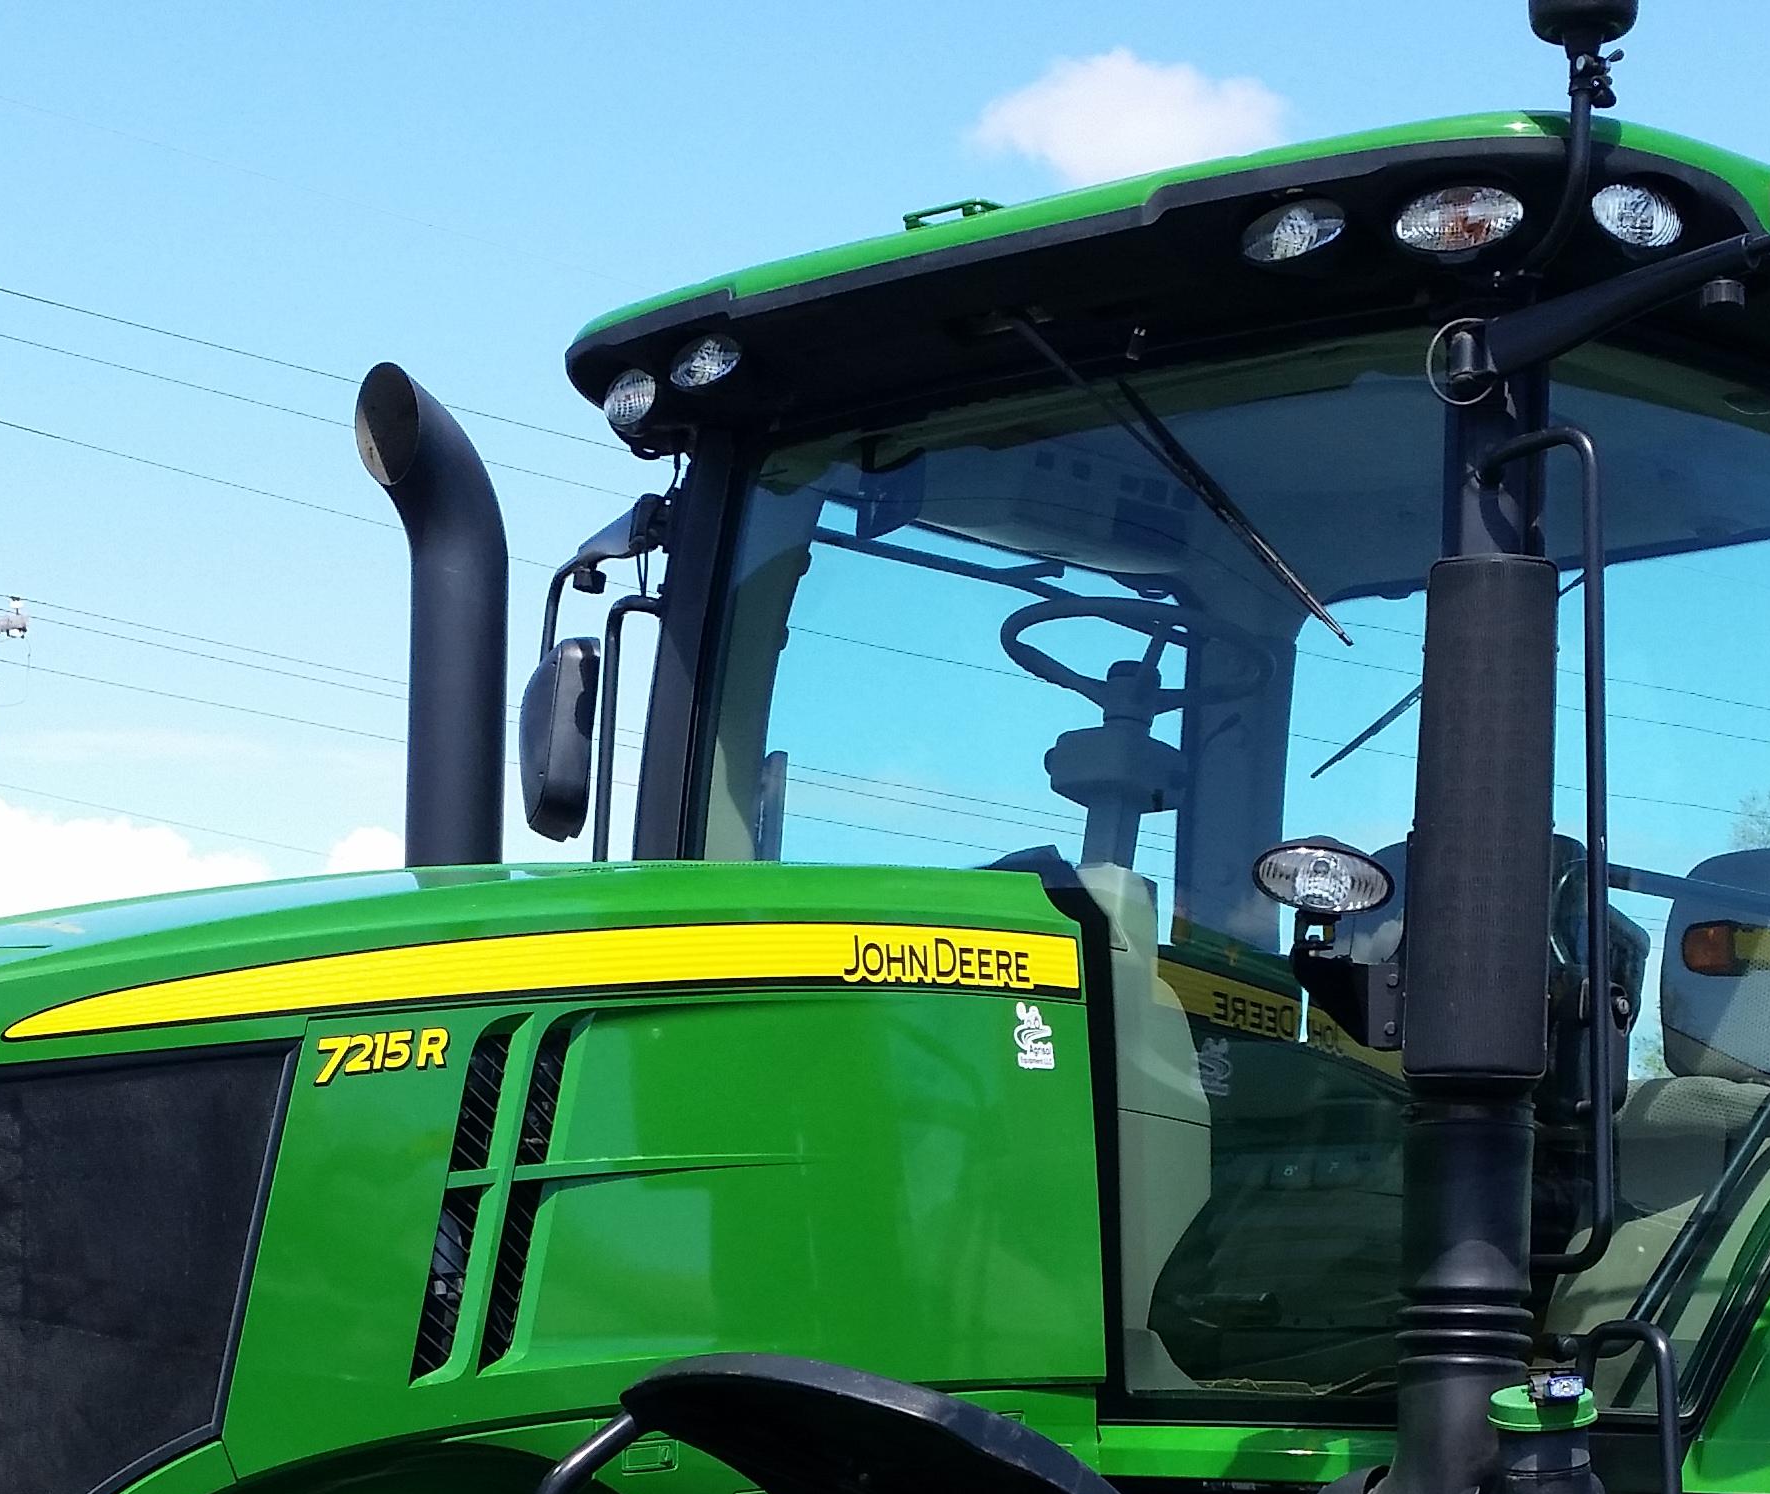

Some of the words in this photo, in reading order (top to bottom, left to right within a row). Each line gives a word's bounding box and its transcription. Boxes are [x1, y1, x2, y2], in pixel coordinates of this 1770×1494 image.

[843, 934, 928, 977] JOHN
[934, 937, 1031, 983] DEERE
[313, 1029, 415, 1087] 7215
[416, 1027, 451, 1070] R
